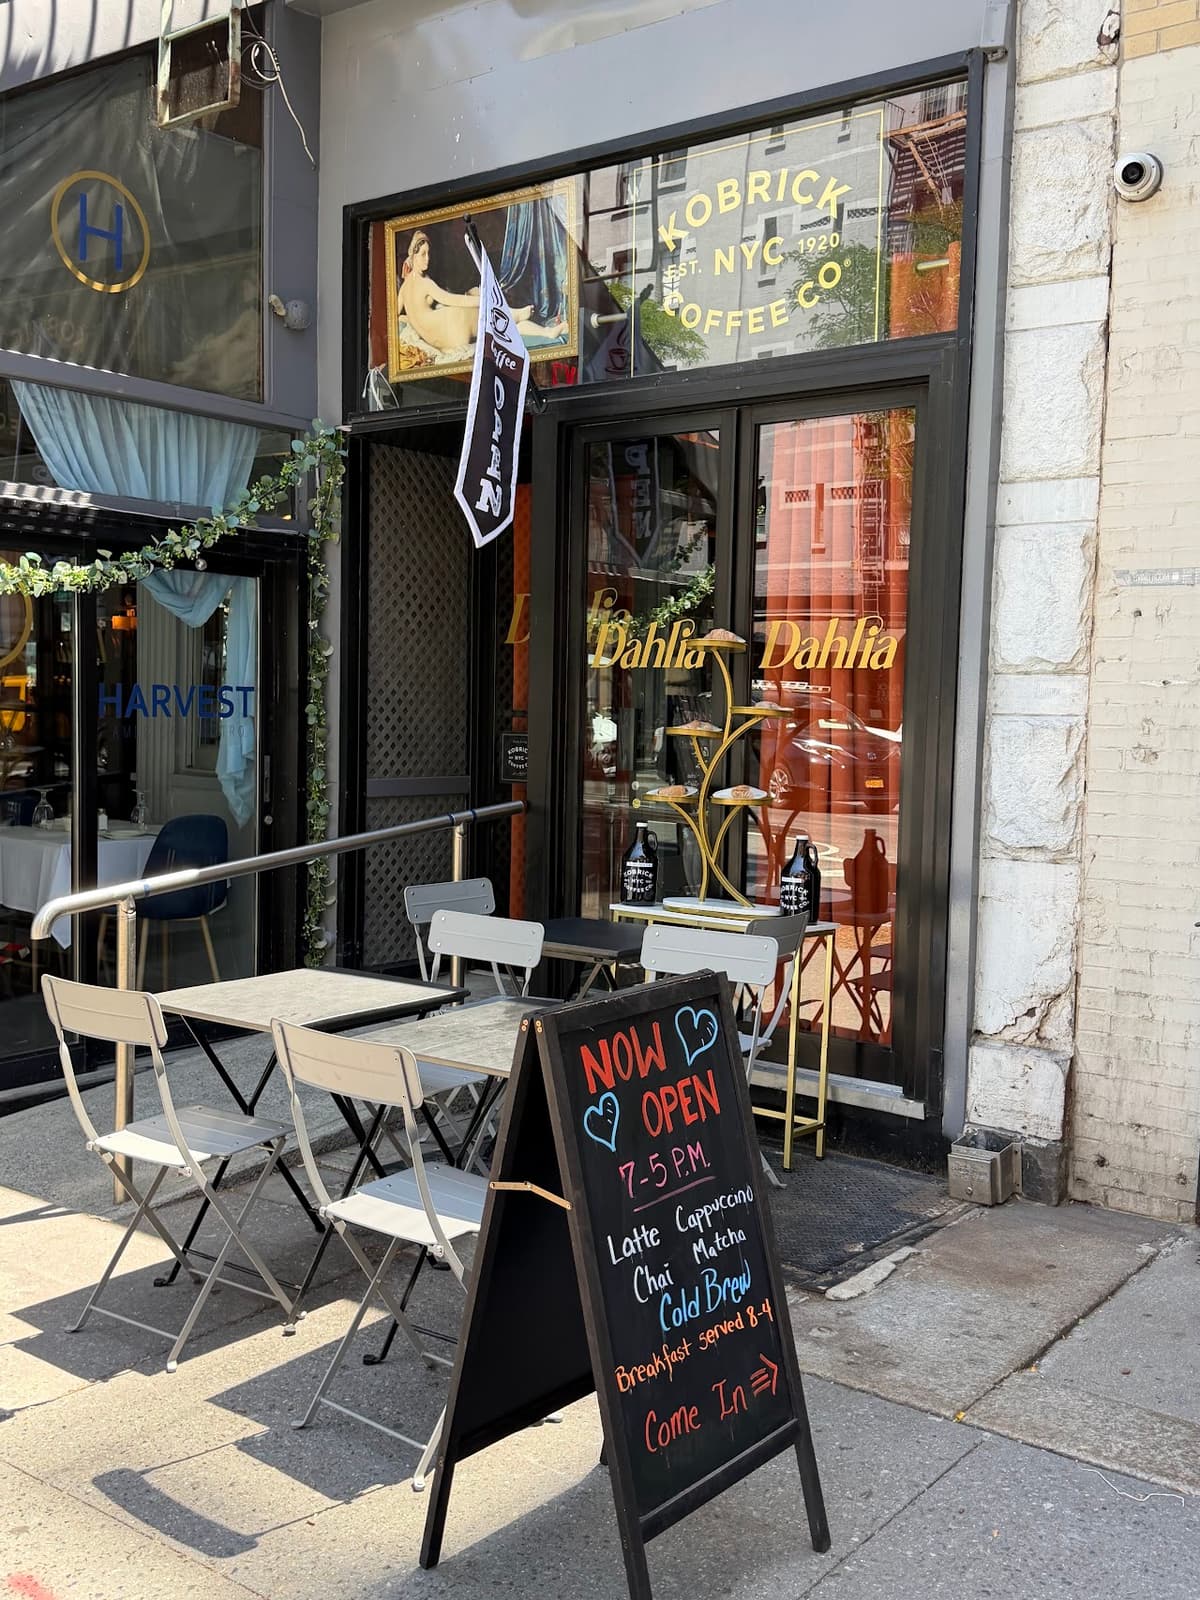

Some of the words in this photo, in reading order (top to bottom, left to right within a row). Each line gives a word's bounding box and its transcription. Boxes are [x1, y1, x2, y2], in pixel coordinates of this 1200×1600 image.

[80, 193, 123, 271] H
[658, 168, 852, 252] KOBRICK
[667, 260, 702, 278] EST.
[714, 236, 784, 276] NYC
[798, 232, 840, 254] 1920
[663, 291, 790, 337] COFFEE
[591, 618, 706, 670] Dahlia
[758, 615, 899, 671] Dahlia
[98, 682, 255, 719] HARVEST
[508, 747, 528, 755] KOBRIC
[624, 869, 654, 879] KOBRICK
[780, 884, 808, 896] OBRICK
[580, 1021, 667, 1095] NOW
[641, 1069, 721, 1138] OPEN
[618, 1152, 668, 1199] 7-5
[607, 1224, 661, 1265] Latte
[675, 1184, 754, 1233] Cappuccino
[633, 1262, 674, 1303] Chai
[692, 1227, 747, 1264] Matcha
[659, 1286, 700, 1332] Cold
[700, 1259, 751, 1313] Brew
[614, 1337, 692, 1393] Breakfast
[698, 1312, 744, 1351] served
[746, 1298, 774, 1329] 8-4
[644, 1402, 702, 1453] Come
[711, 1379, 748, 1421] In
